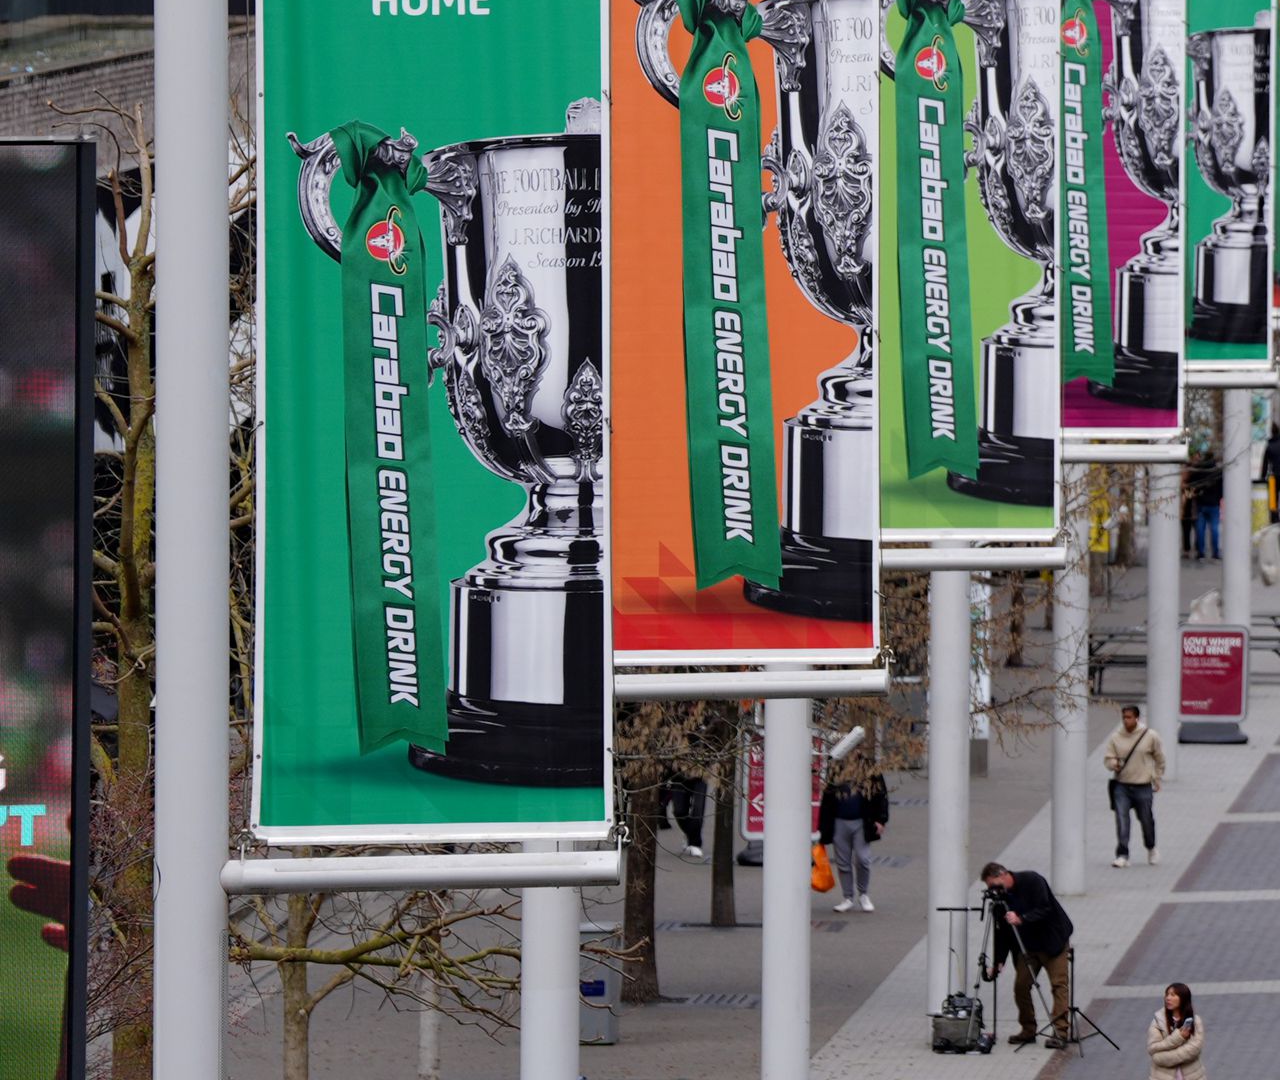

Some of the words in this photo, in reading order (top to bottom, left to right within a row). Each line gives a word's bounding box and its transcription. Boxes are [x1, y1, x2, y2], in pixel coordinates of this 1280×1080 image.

[918, 97, 948, 242] Carabao
[1064, 62, 1089, 185] Carabao
[707, 128, 744, 302] Carabao
[1067, 191, 1092, 281] ENERGY
[923, 248, 950, 354] ENERGY
[1071, 284, 1095, 354] DRINK
[370, 281, 409, 461] Carabao
[713, 309, 748, 438] ENERGY
[929, 358, 956, 441] DRINK
[378, 469, 412, 600] ENERGY
[719, 444, 755, 544] DRINK
[386, 606, 420, 707] DRINK
